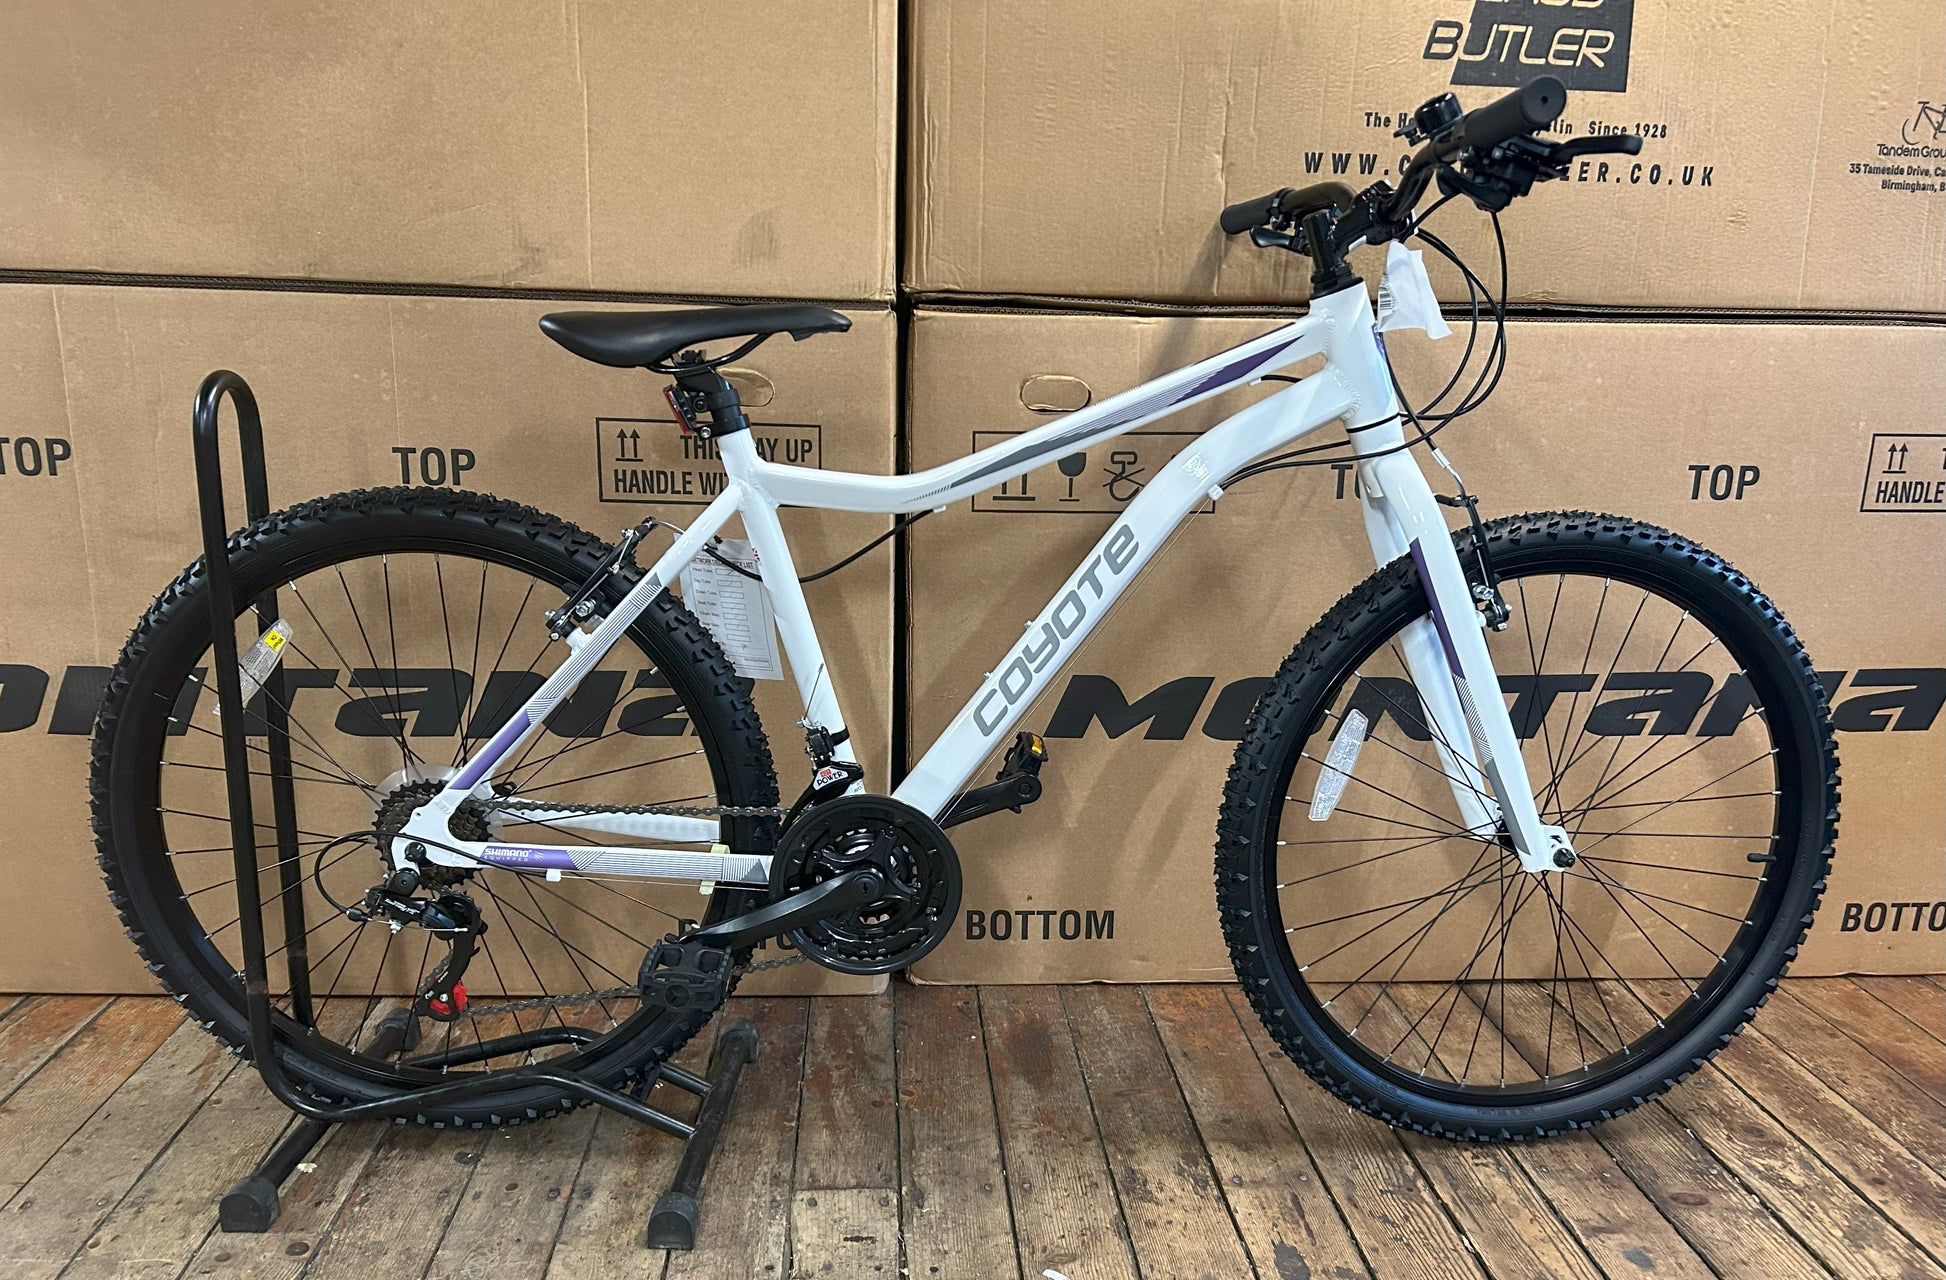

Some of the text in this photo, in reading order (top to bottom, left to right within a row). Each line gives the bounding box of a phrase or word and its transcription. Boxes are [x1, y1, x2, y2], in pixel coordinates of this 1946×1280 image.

[1422, 20, 1616, 68] BUTLER
[1365, 111, 1391, 128] The
[1588, 120, 1627, 136] Since
[1634, 122, 1667, 138] 1928
[1876, 143, 1919, 157] Tandem
[1849, 163, 1861, 173] 35
[1862, 163, 1905, 175] Tameside
[1906, 165, 1932, 178] Drive,
[1881, 179, 1938, 193] Birmingham,
[755, 437, 779, 462] AY
[785, 438, 813, 463] UP
[391, 446, 476, 486] TOP
[613, 468, 693, 495] HANDLE
[1687, 464, 1760, 501] TOP
[1875, 481, 1946, 504] HANDLE
[816, 770, 843, 786] POWER
[484, 847, 529, 858] SHIMANO
[964, 909, 1116, 941] BOTTOM
[1840, 902, 1946, 933] BOTTO
